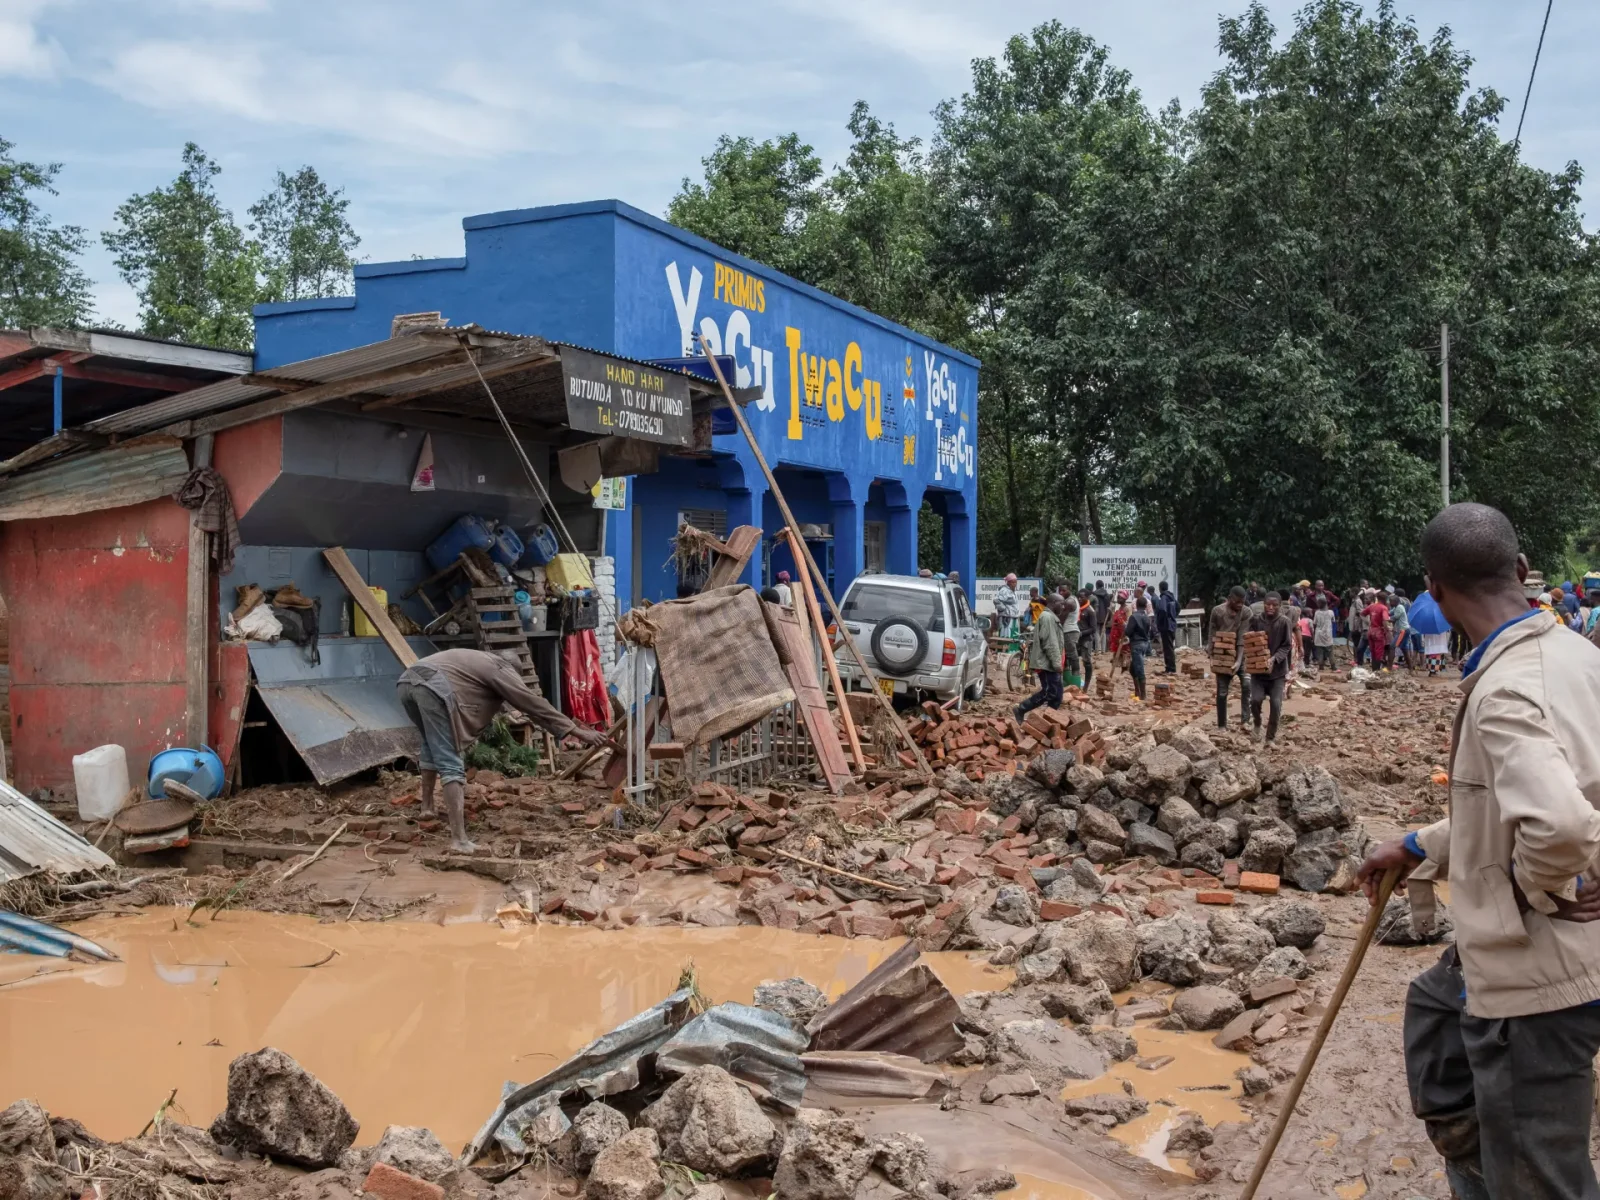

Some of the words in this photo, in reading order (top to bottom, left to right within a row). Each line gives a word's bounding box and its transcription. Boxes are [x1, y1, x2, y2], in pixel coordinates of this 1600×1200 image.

[713, 261, 766, 314] PRIMUS
[570, 377, 612, 403] BUTUNDA
[620, 387, 633, 407] YO
[635, 389, 647, 410] KU
[650, 394, 683, 417] NYUNDO
[640, 372, 664, 392] HARI
